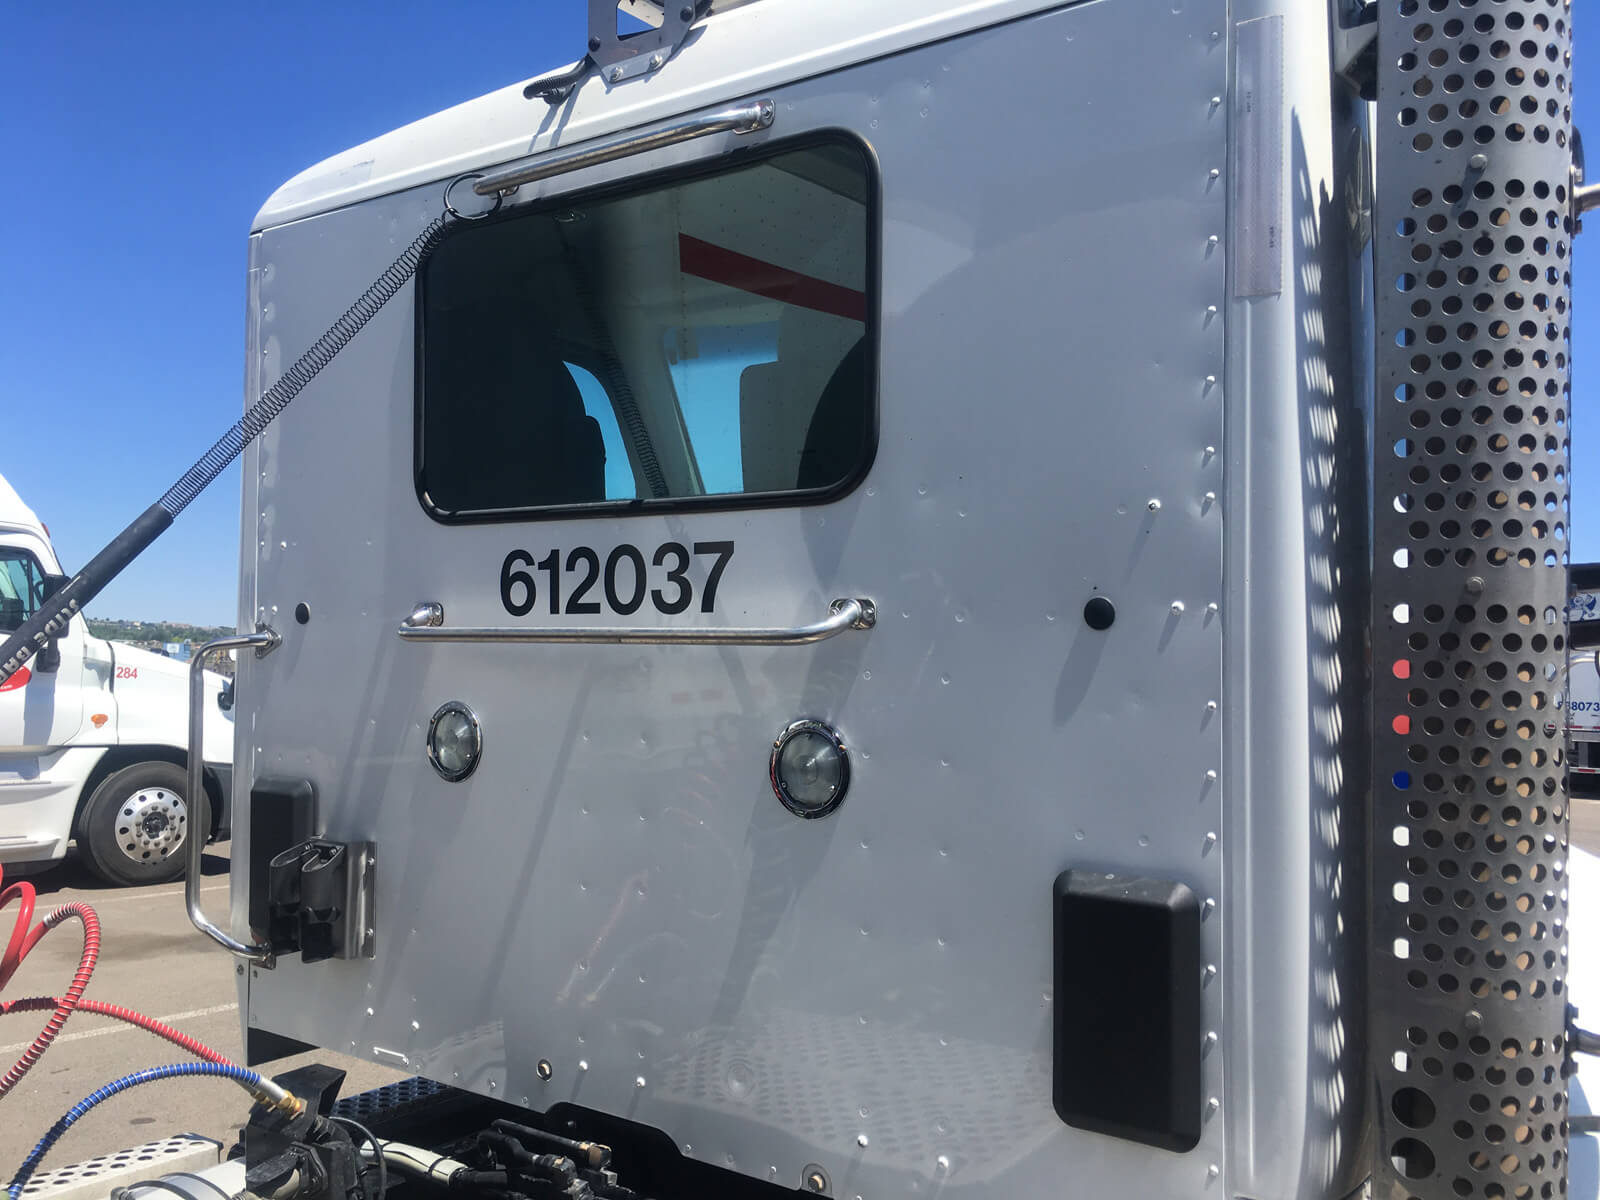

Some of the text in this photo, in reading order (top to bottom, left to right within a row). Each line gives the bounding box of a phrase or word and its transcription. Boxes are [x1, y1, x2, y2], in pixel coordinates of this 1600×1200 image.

[500, 541, 734, 617] 612037
[33, 599, 79, 645] SLIDE
[116, 666, 138, 679] 284
